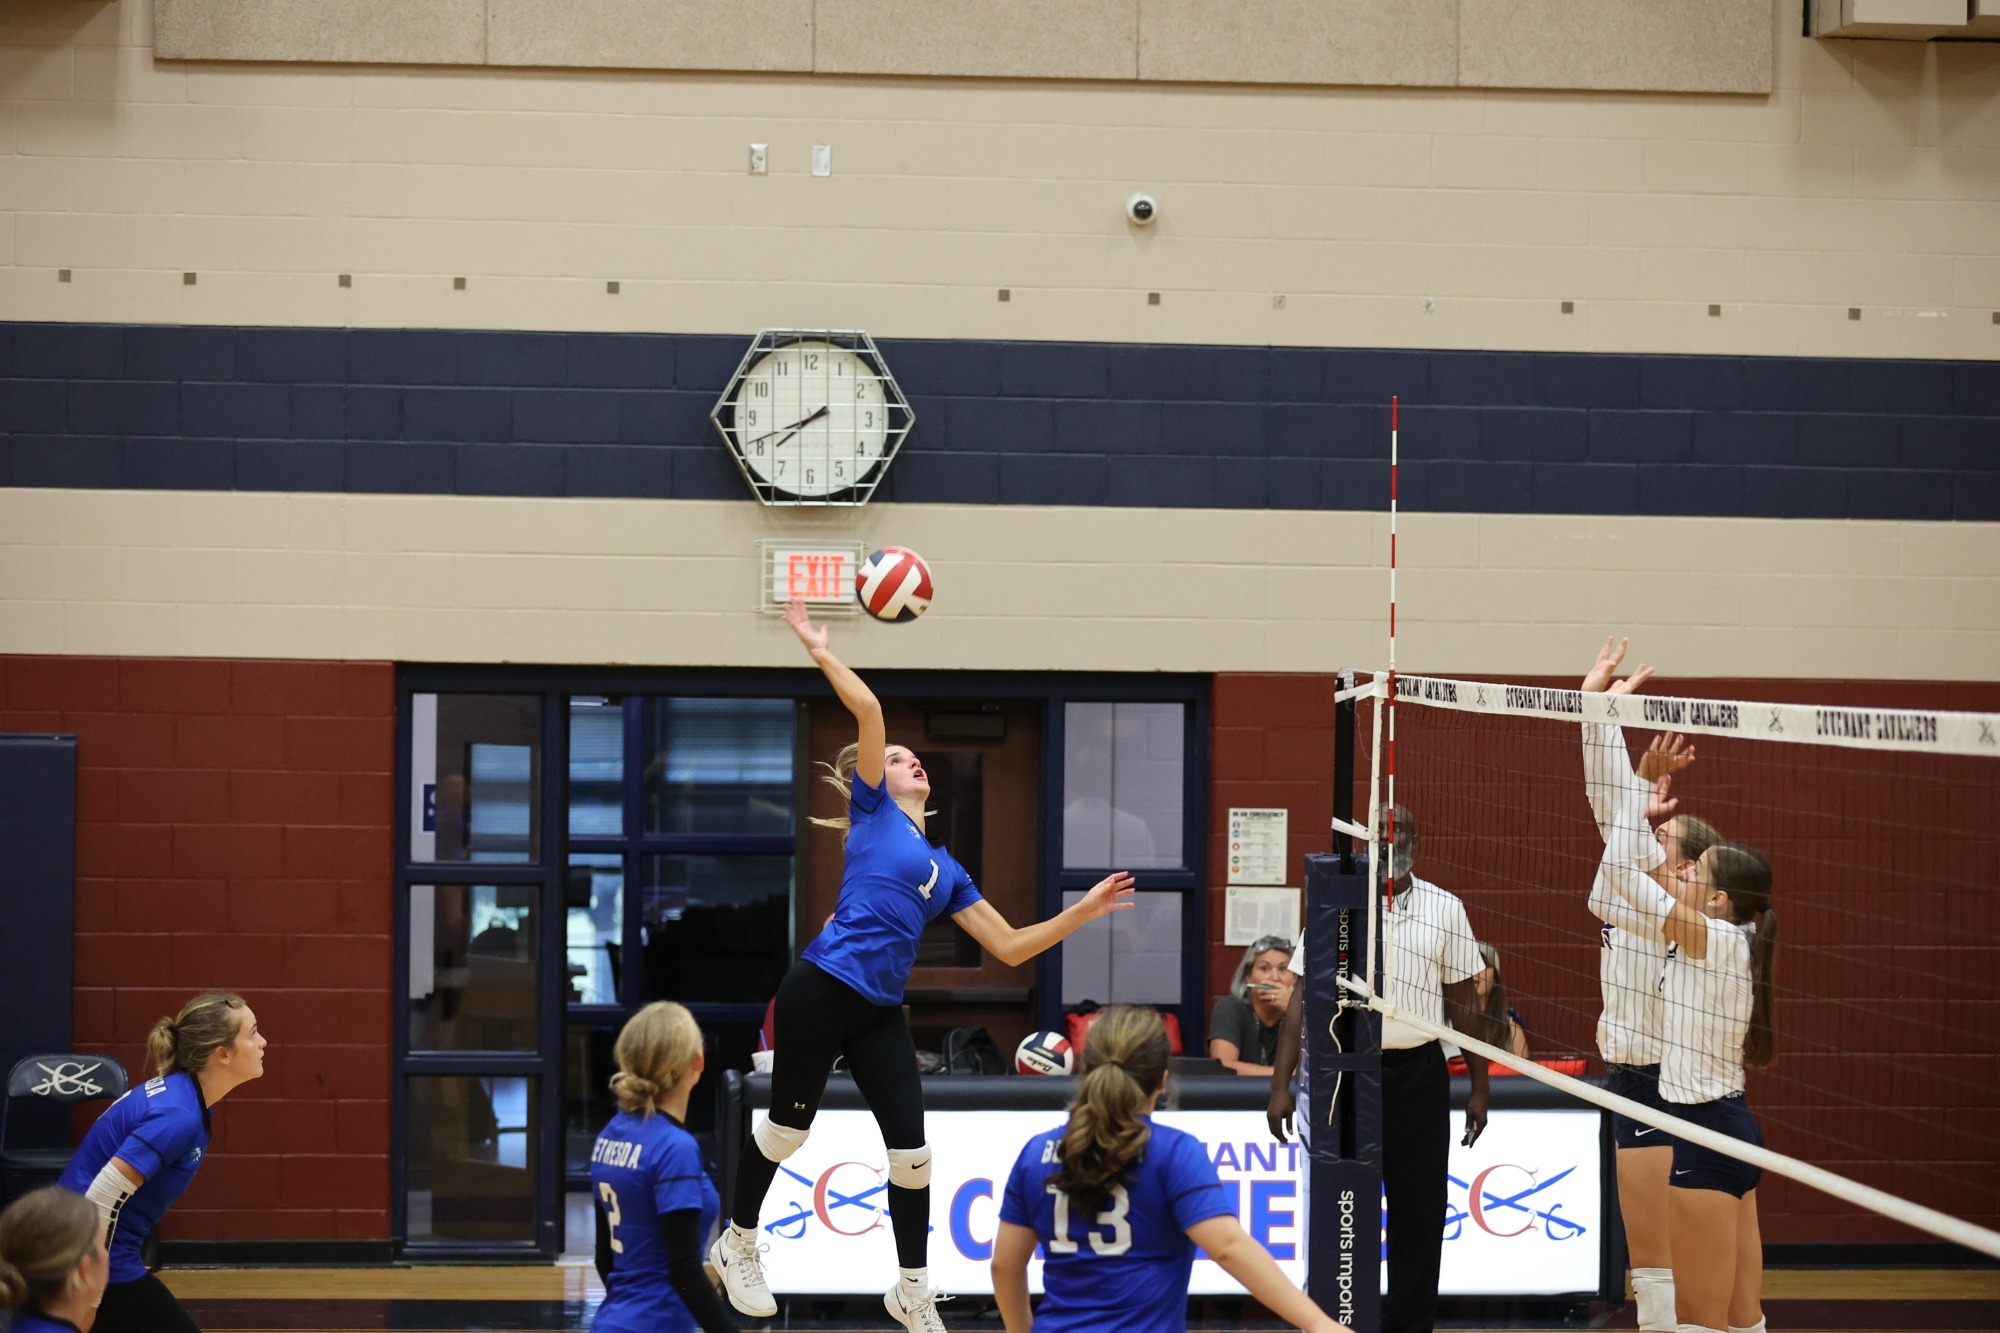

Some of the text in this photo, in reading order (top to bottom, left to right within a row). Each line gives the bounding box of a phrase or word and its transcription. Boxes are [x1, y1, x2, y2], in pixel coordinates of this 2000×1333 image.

[777, 362, 788, 376] 11
[804, 354, 818, 370] 12
[754, 382, 768, 397] 10
[857, 383, 865, 399] 2
[749, 411, 756, 426] 9
[865, 411, 873, 428] 3
[756, 439, 764, 456] 8
[857, 441, 865, 457] 4
[777, 461, 786, 476] 7
[806, 469, 814, 484] 6
[834, 462, 843, 477] 5
[788, 555, 845, 598] EXIT
[1643, 699, 1739, 729] COVENANT CAVALIERS
[917, 857, 940, 900] 1
[1338, 907, 1349, 951] sports
[590, 1136, 643, 1169] ETHESDA
[598, 1181, 624, 1255] 2
[1045, 1183, 1133, 1256] 13
[1335, 1190, 1356, 1326] sports imports
